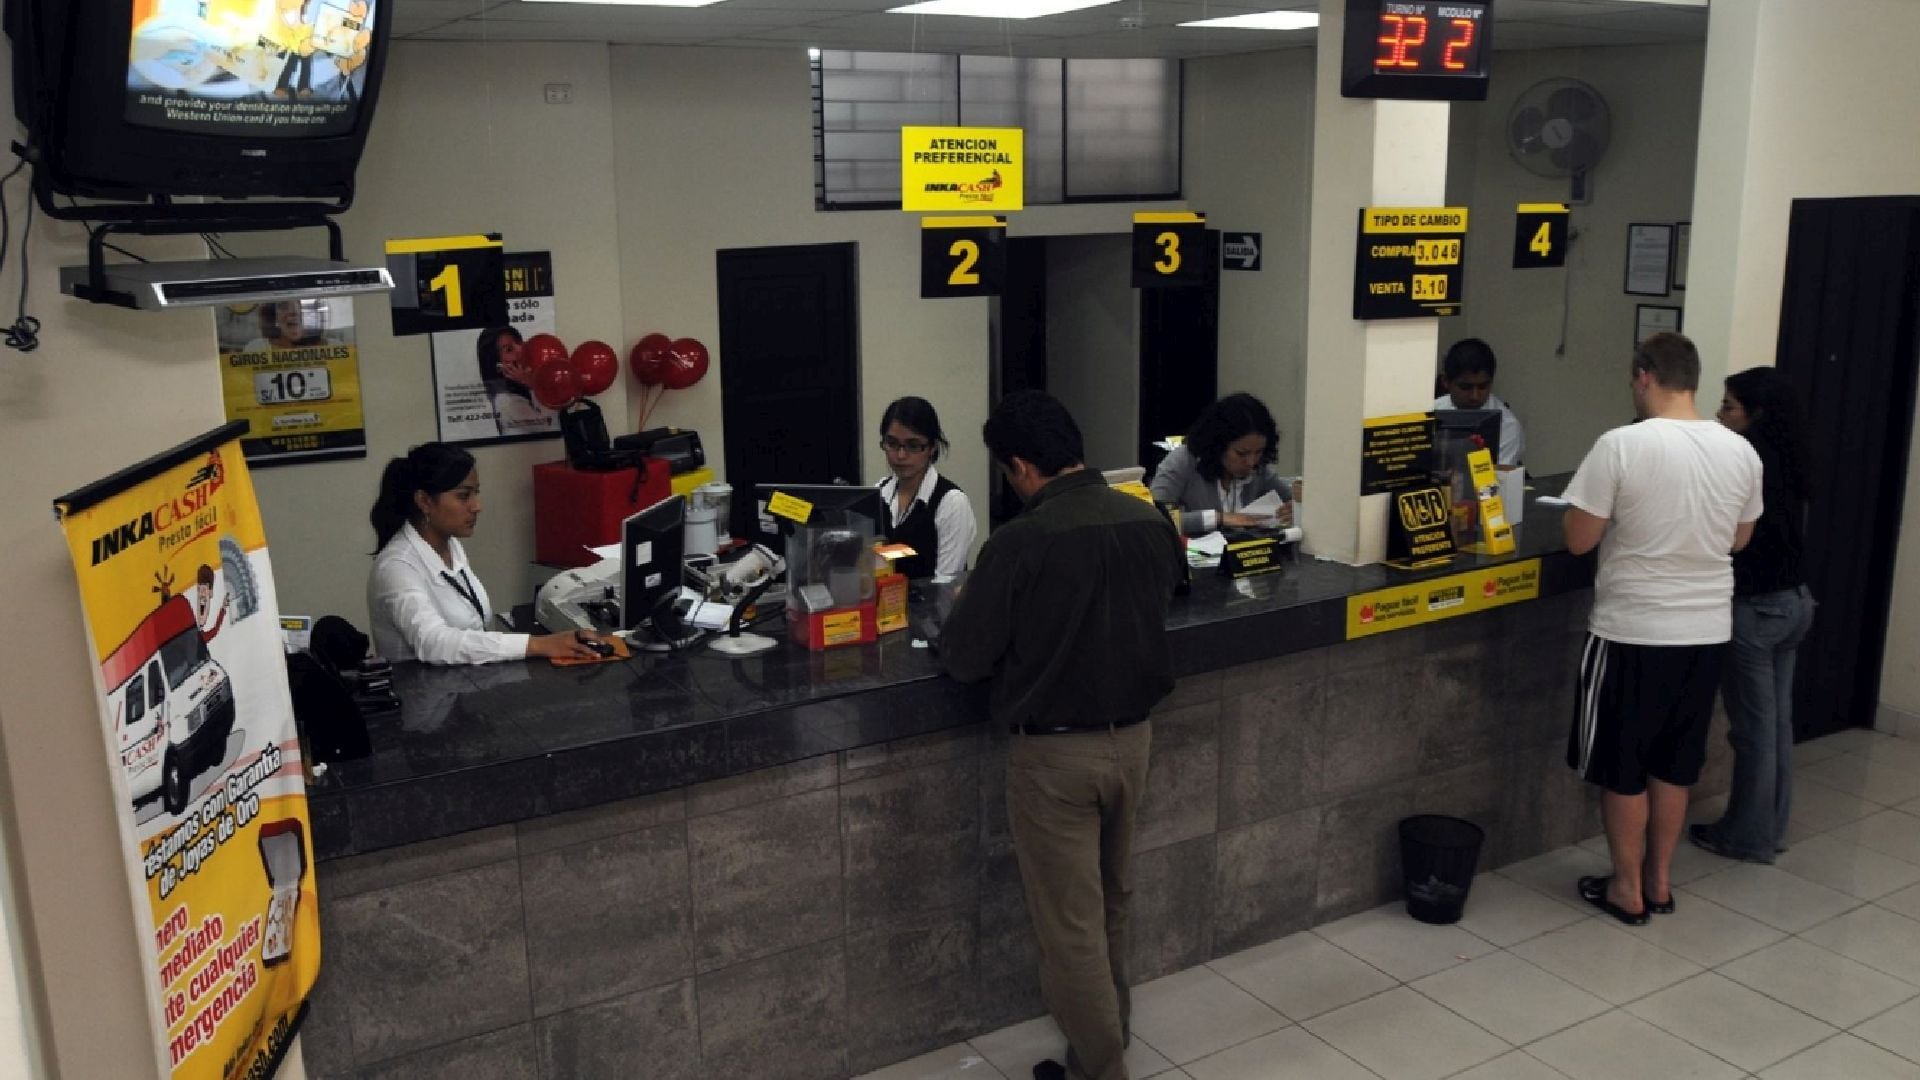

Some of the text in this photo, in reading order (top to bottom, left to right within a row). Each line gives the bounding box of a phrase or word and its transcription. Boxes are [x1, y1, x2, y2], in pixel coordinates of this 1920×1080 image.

[1387, 3, 1414, 14] TURNO
[1375, 14, 1427, 67] 32
[1443, 20, 1475, 69] 2
[164, 97, 207, 109] provide
[208, 102, 233, 111] your
[233, 102, 290, 113] identification
[166, 107, 211, 120] Western
[213, 110, 243, 122] Union
[914, 152, 1013, 164] PREFERENCIAL
[930, 138, 997, 150] ATENCION
[1373, 214, 1461, 227] TIPO DE CAMBIO
[1529, 221, 1552, 257] 4
[948, 239, 980, 285] 2
[1154, 231, 1182, 274] 3
[430, 264, 464, 318] 1
[1369, 282, 1405, 294] VENTA
[229, 354, 269, 368] GIROS
[271, 347, 350, 364] NACIONALES
[91, 484, 208, 567] INKACASH
[202, 789, 224, 828] con
[159, 792, 260, 900] de Joyas de Oro
[189, 917, 261, 1002] cualquier
